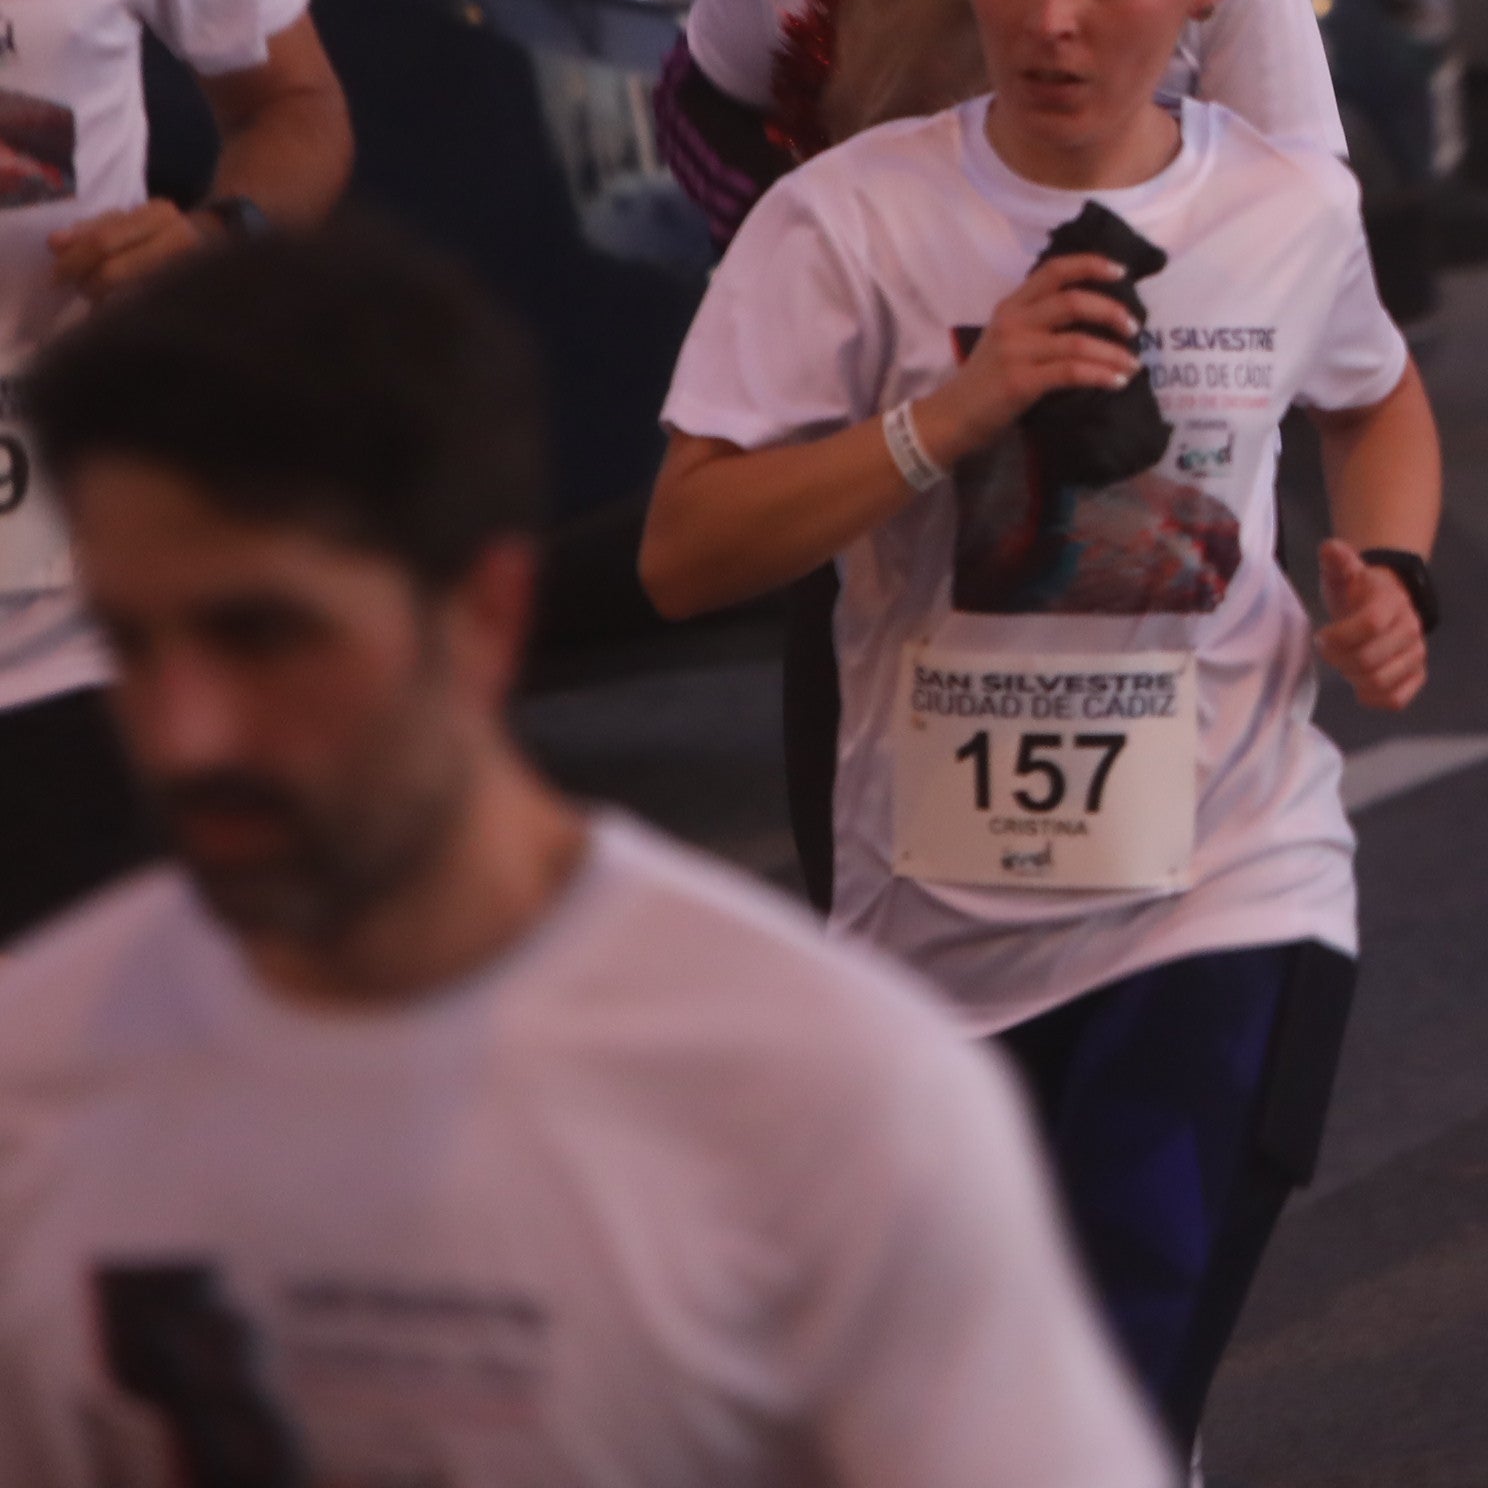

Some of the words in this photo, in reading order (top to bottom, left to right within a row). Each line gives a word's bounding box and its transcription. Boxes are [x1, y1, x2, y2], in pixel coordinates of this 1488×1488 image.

[913, 666, 971, 690] SAN
[981, 672, 1176, 694] SILVESTRE
[912, 688, 1023, 717] CIUDAD
[1031, 694, 1072, 719] DE
[954, 729, 1129, 815] 157
[988, 817, 1089, 837] CRISTINA
